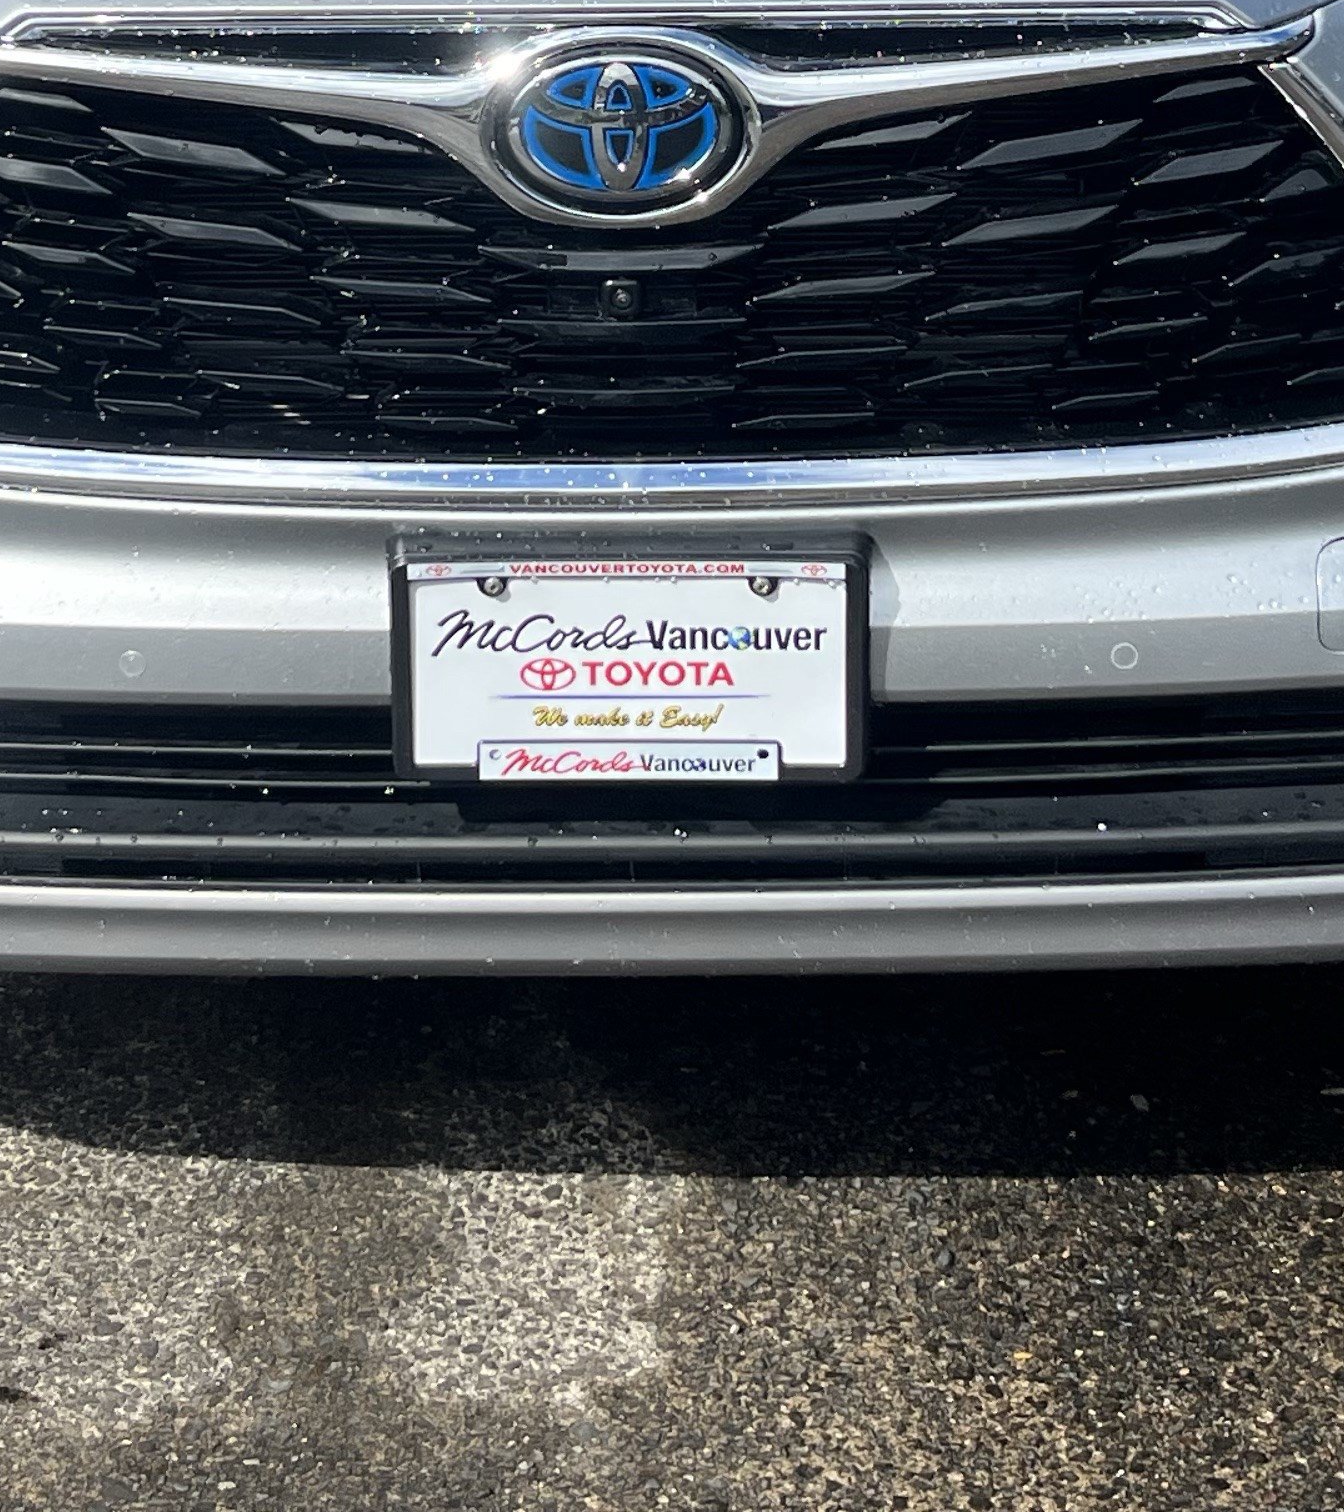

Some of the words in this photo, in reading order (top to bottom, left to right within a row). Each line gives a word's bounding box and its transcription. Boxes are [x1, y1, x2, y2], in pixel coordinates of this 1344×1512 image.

[509, 563, 745, 574] VANCOUVERTOYOTA.COM
[431, 609, 652, 657] McCords
[645, 619, 828, 652] Vancouver
[582, 660, 735, 687] TOYOTA
[532, 704, 568, 727] We
[573, 706, 631, 727] make
[635, 709, 654, 727] it
[659, 703, 725, 732] Easy!
[501, 748, 643, 776] McCords
[639, 753, 757, 772] Vancouver
